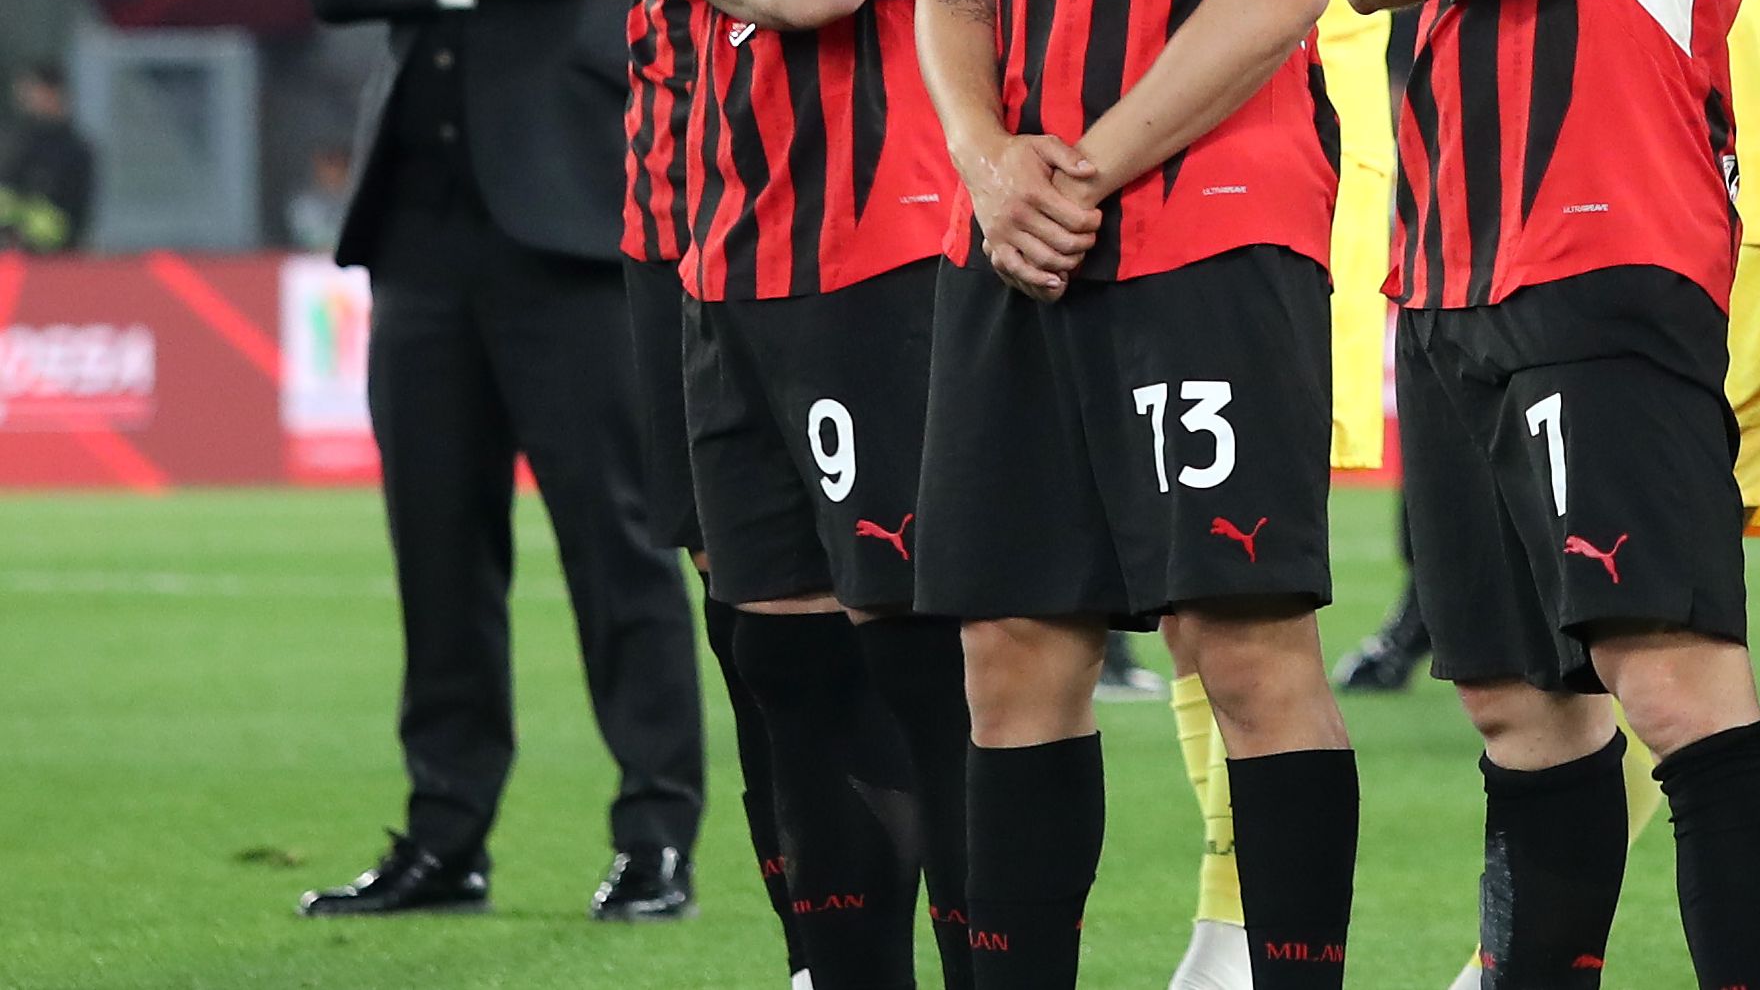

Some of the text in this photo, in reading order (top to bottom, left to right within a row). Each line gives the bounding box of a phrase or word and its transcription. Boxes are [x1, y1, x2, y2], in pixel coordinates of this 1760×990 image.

[808, 398, 856, 503] 9
[1132, 380, 1236, 493] 73
[1525, 392, 1567, 517] 7
[1265, 943, 1344, 963] MILAN
